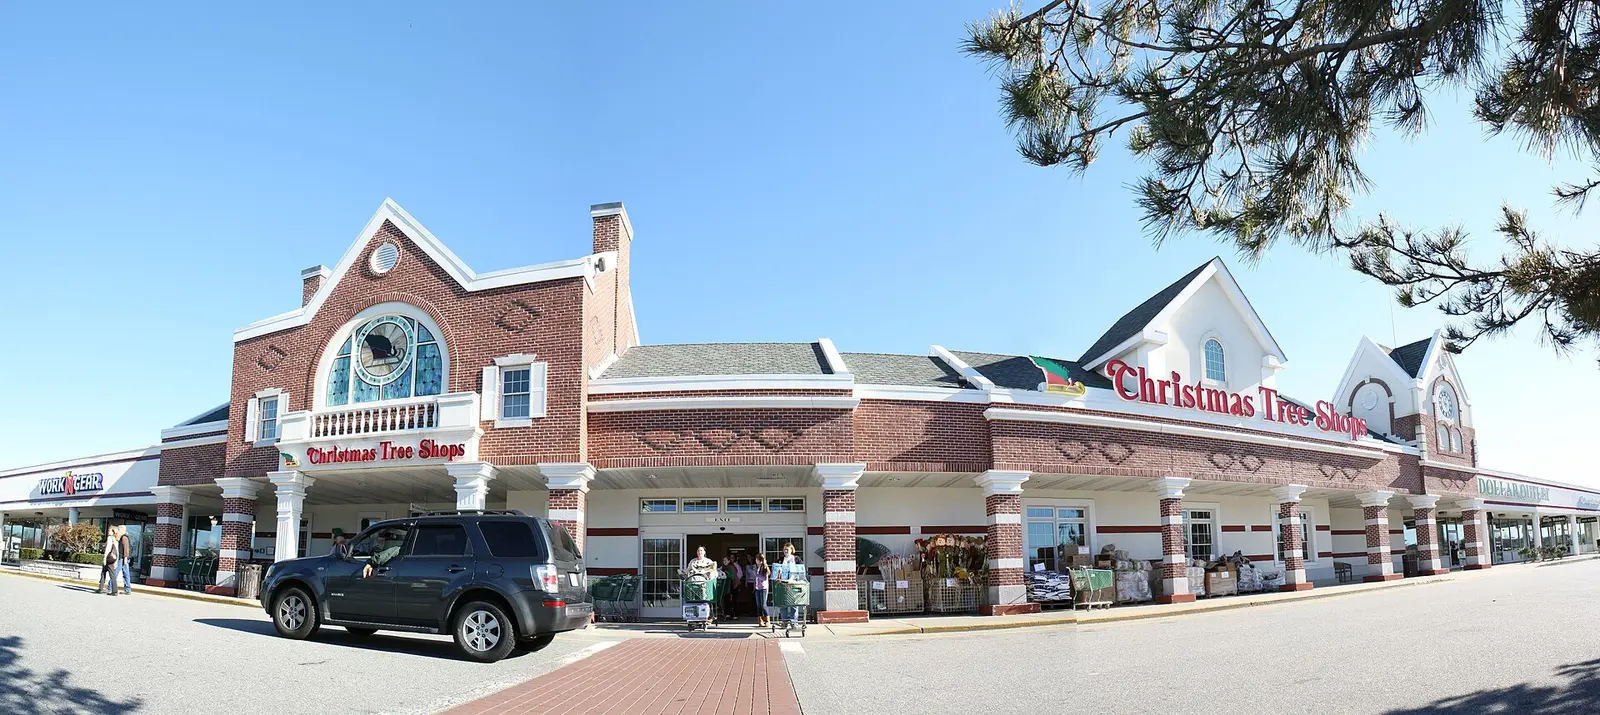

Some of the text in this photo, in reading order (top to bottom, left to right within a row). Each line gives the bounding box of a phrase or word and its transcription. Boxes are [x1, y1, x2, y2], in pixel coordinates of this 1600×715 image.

[1104, 359, 1368, 441] Christmas Tree Shops
[307, 439, 465, 464] Christmas Tree Shops
[40, 477, 66, 495] WORK
[74, 473, 103, 492] GEAR
[1478, 478, 1518, 497] DOLLAR
